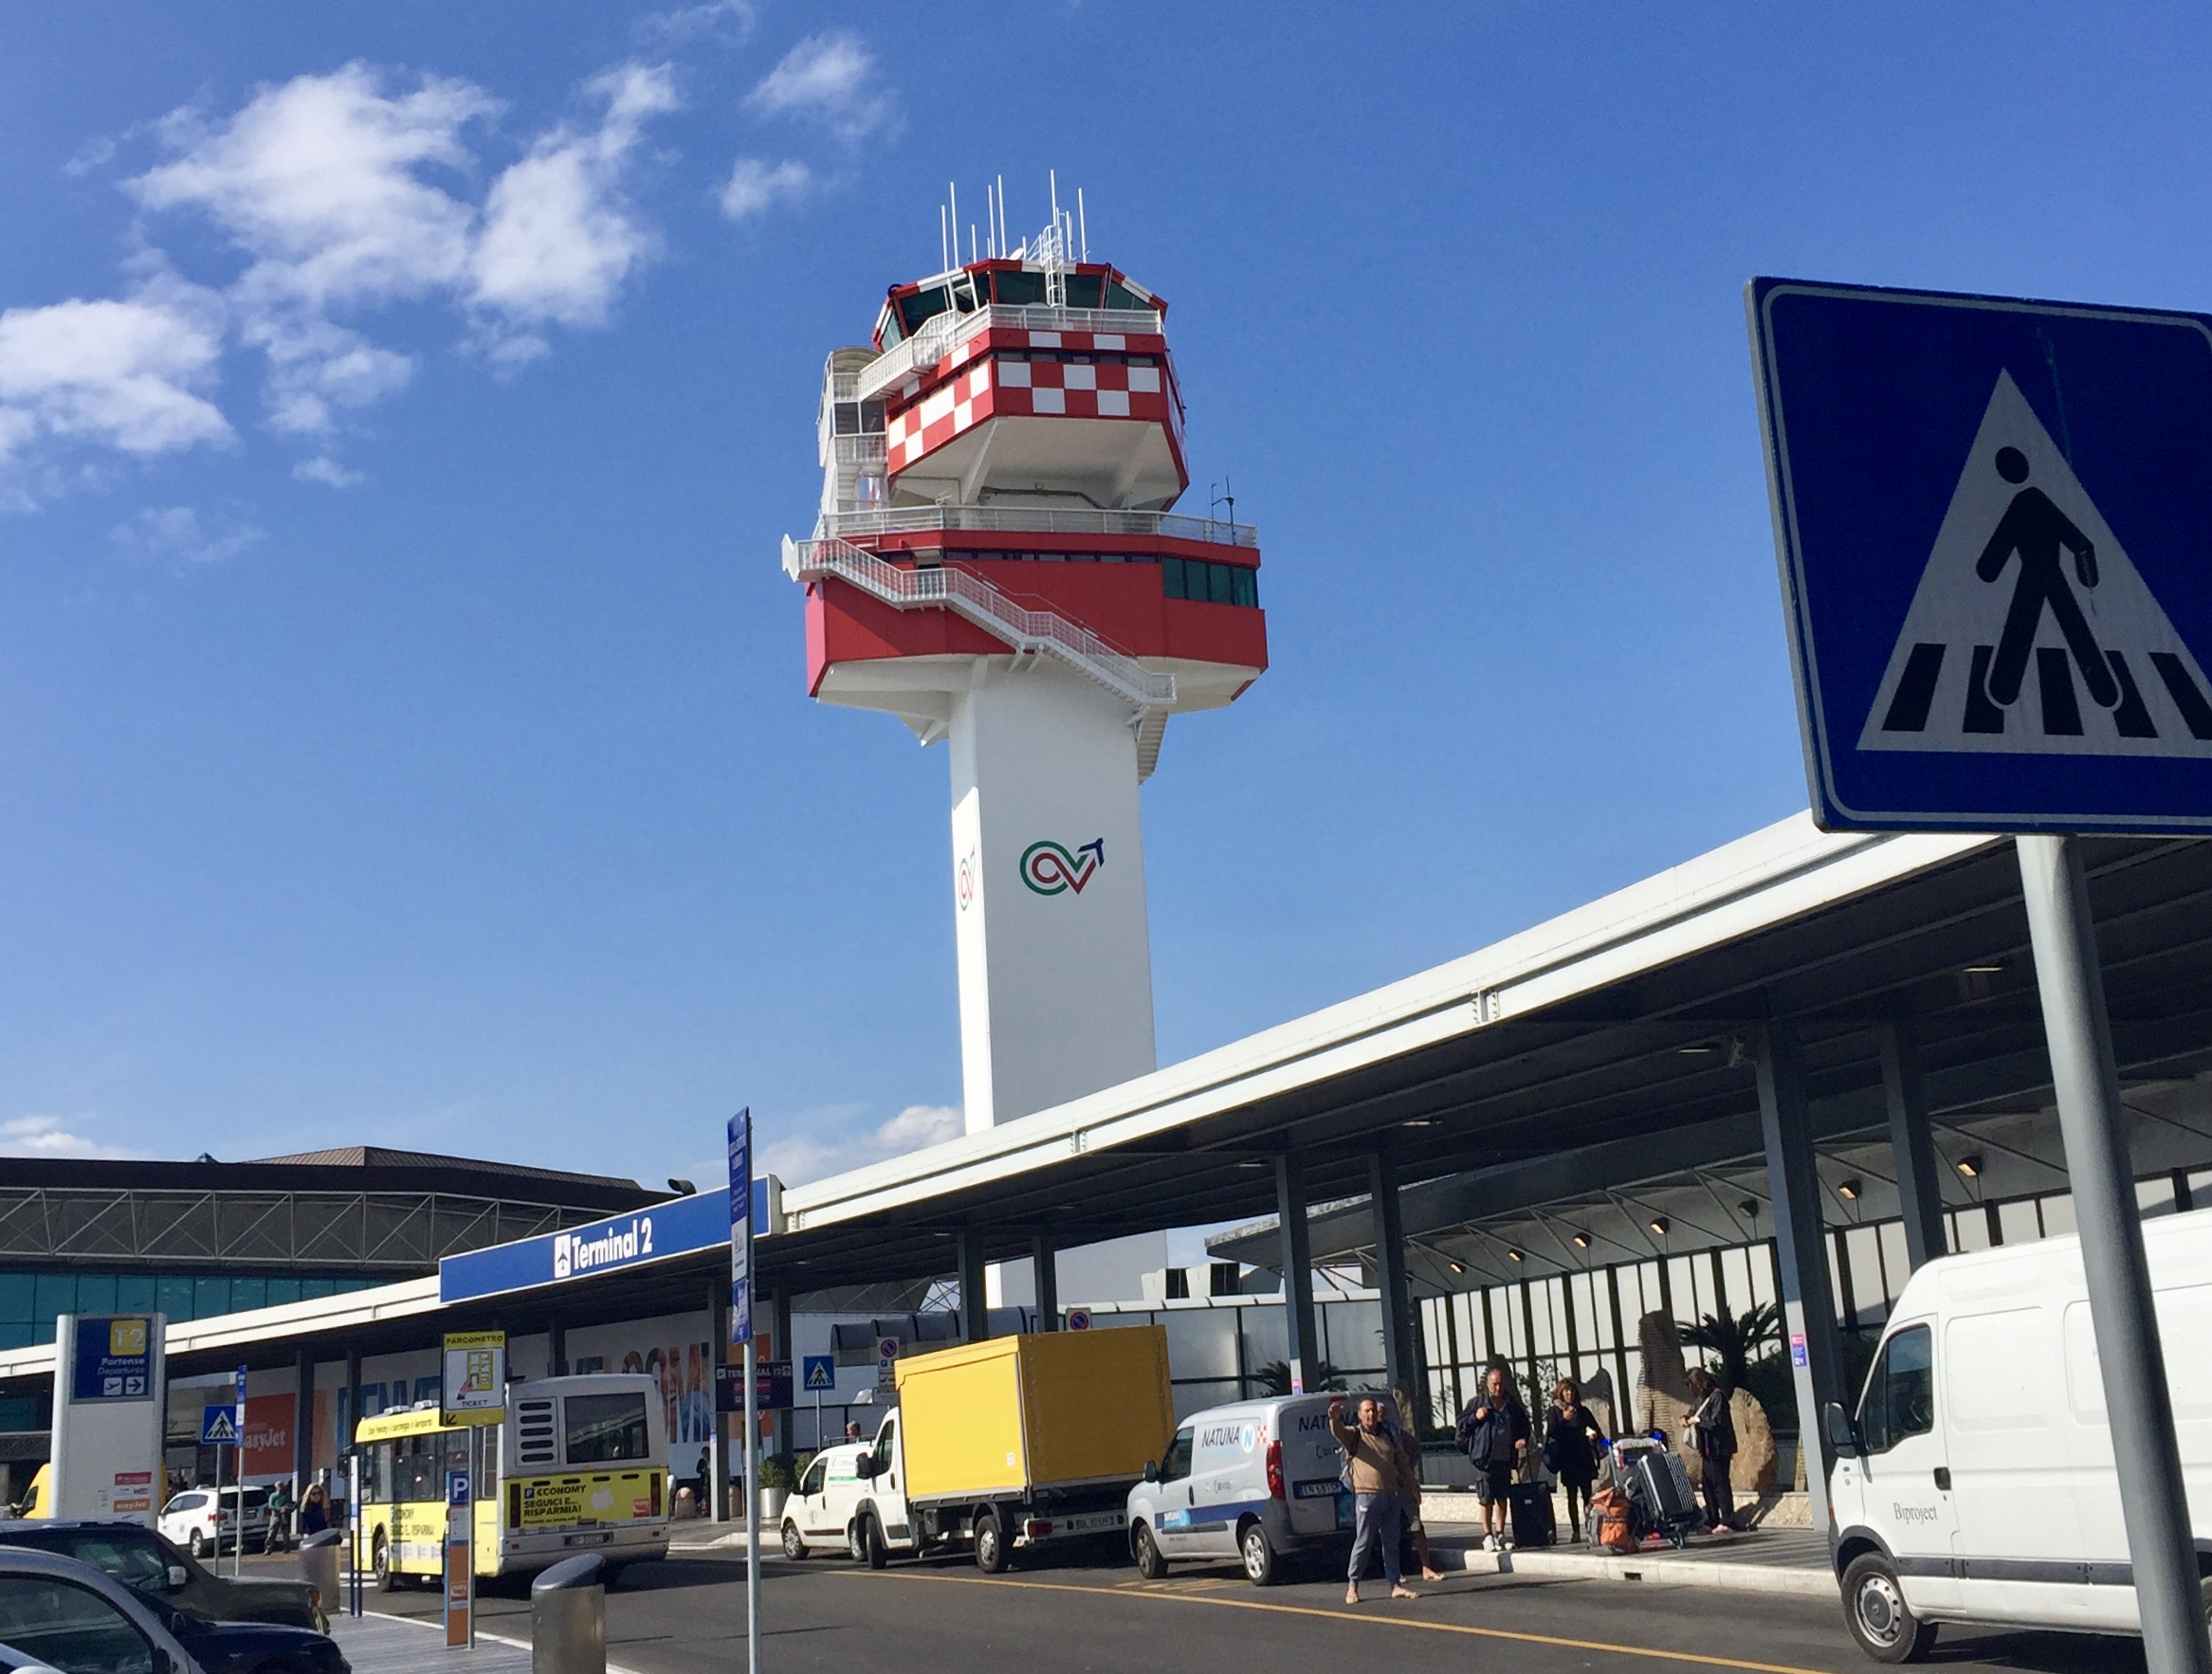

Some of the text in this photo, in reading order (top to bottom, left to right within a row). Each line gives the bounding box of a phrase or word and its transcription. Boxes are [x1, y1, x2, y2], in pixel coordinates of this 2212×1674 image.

[572, 1217, 653, 1270] Terminal 2
[446, 1335, 503, 1344] PARCOMETRO
[461, 1399, 488, 1408] TICKET
[1298, 1412, 1359, 1432] NATNA
[1201, 1426, 1240, 1447] NATUNA
[453, 1477, 468, 1499] P
[523, 1498, 562, 1509] SEGUICI
[523, 1505, 582, 1518] RISPARMIA!
[1892, 1502, 1938, 1525] Biproject
